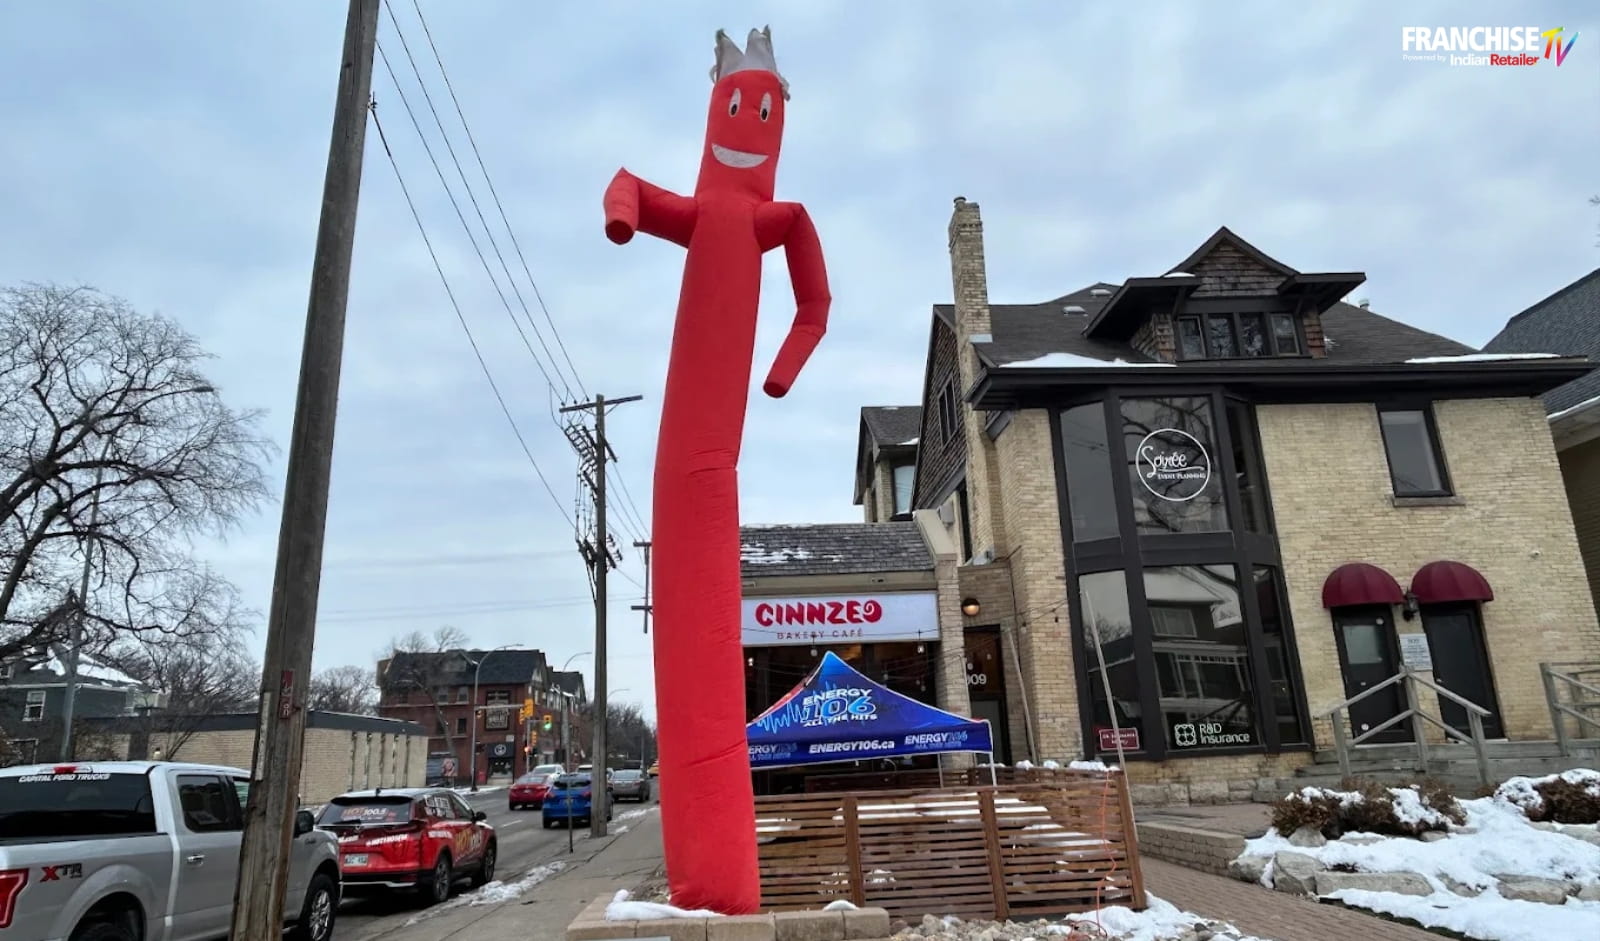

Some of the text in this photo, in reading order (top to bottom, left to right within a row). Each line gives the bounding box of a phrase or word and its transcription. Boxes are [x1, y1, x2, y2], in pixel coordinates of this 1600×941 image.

[1141, 445, 1187, 478] Soirée
[755, 600, 883, 627] CINNZEO
[777, 627, 864, 640] BAKERY CAFÉ
[802, 688, 872, 706] ENERGY
[801, 696, 876, 723] 106
[1200, 723, 1222, 734] R&D
[1200, 733, 1250, 744] Insurance
[809, 740, 895, 754] ENERGY106.ca
[19, 774, 52, 782] CAPITAL
[40, 863, 82, 882] XTR
